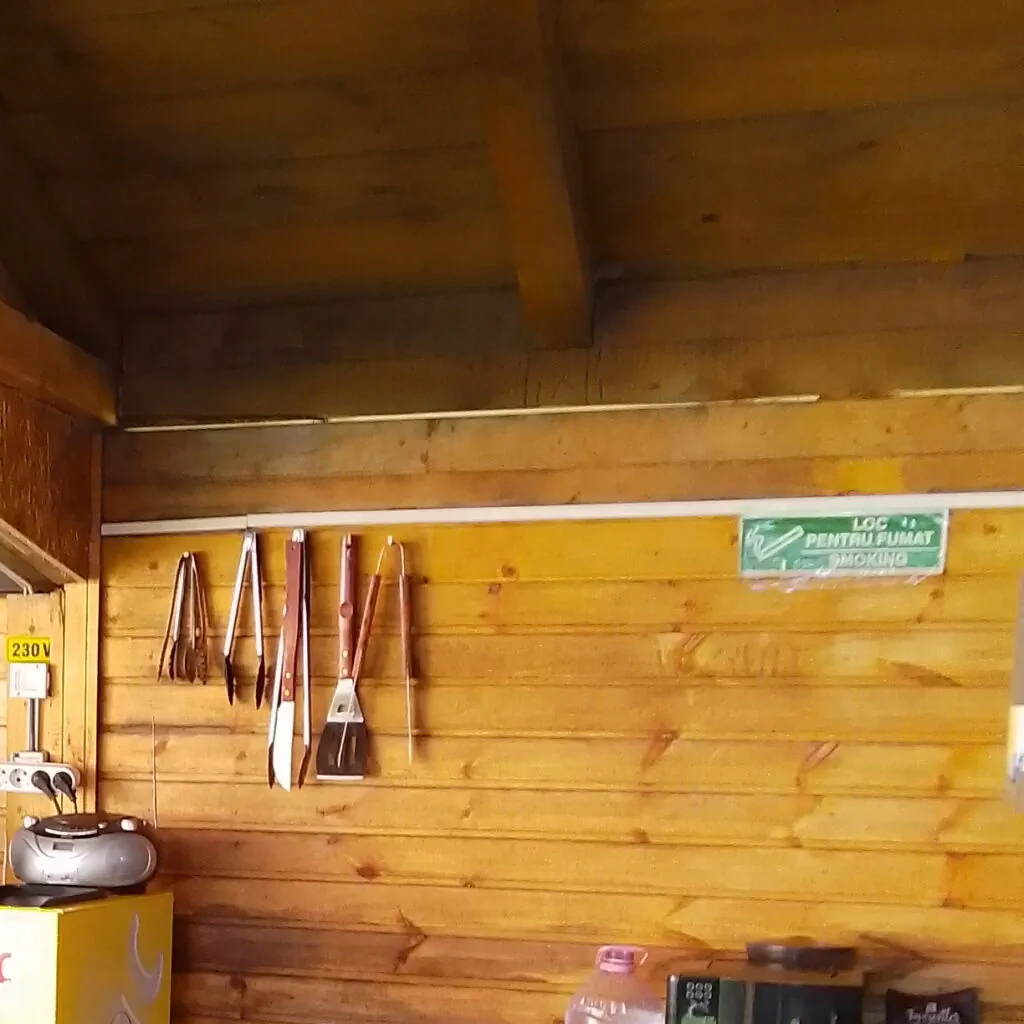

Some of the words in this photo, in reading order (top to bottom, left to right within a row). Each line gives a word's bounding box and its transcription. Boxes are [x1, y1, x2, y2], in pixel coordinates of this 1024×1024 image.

[852, 516, 889, 532] LOC
[805, 532, 874, 549] PENTRU
[876, 530, 936, 547] FUMAT
[12, 642, 40, 658] 230
